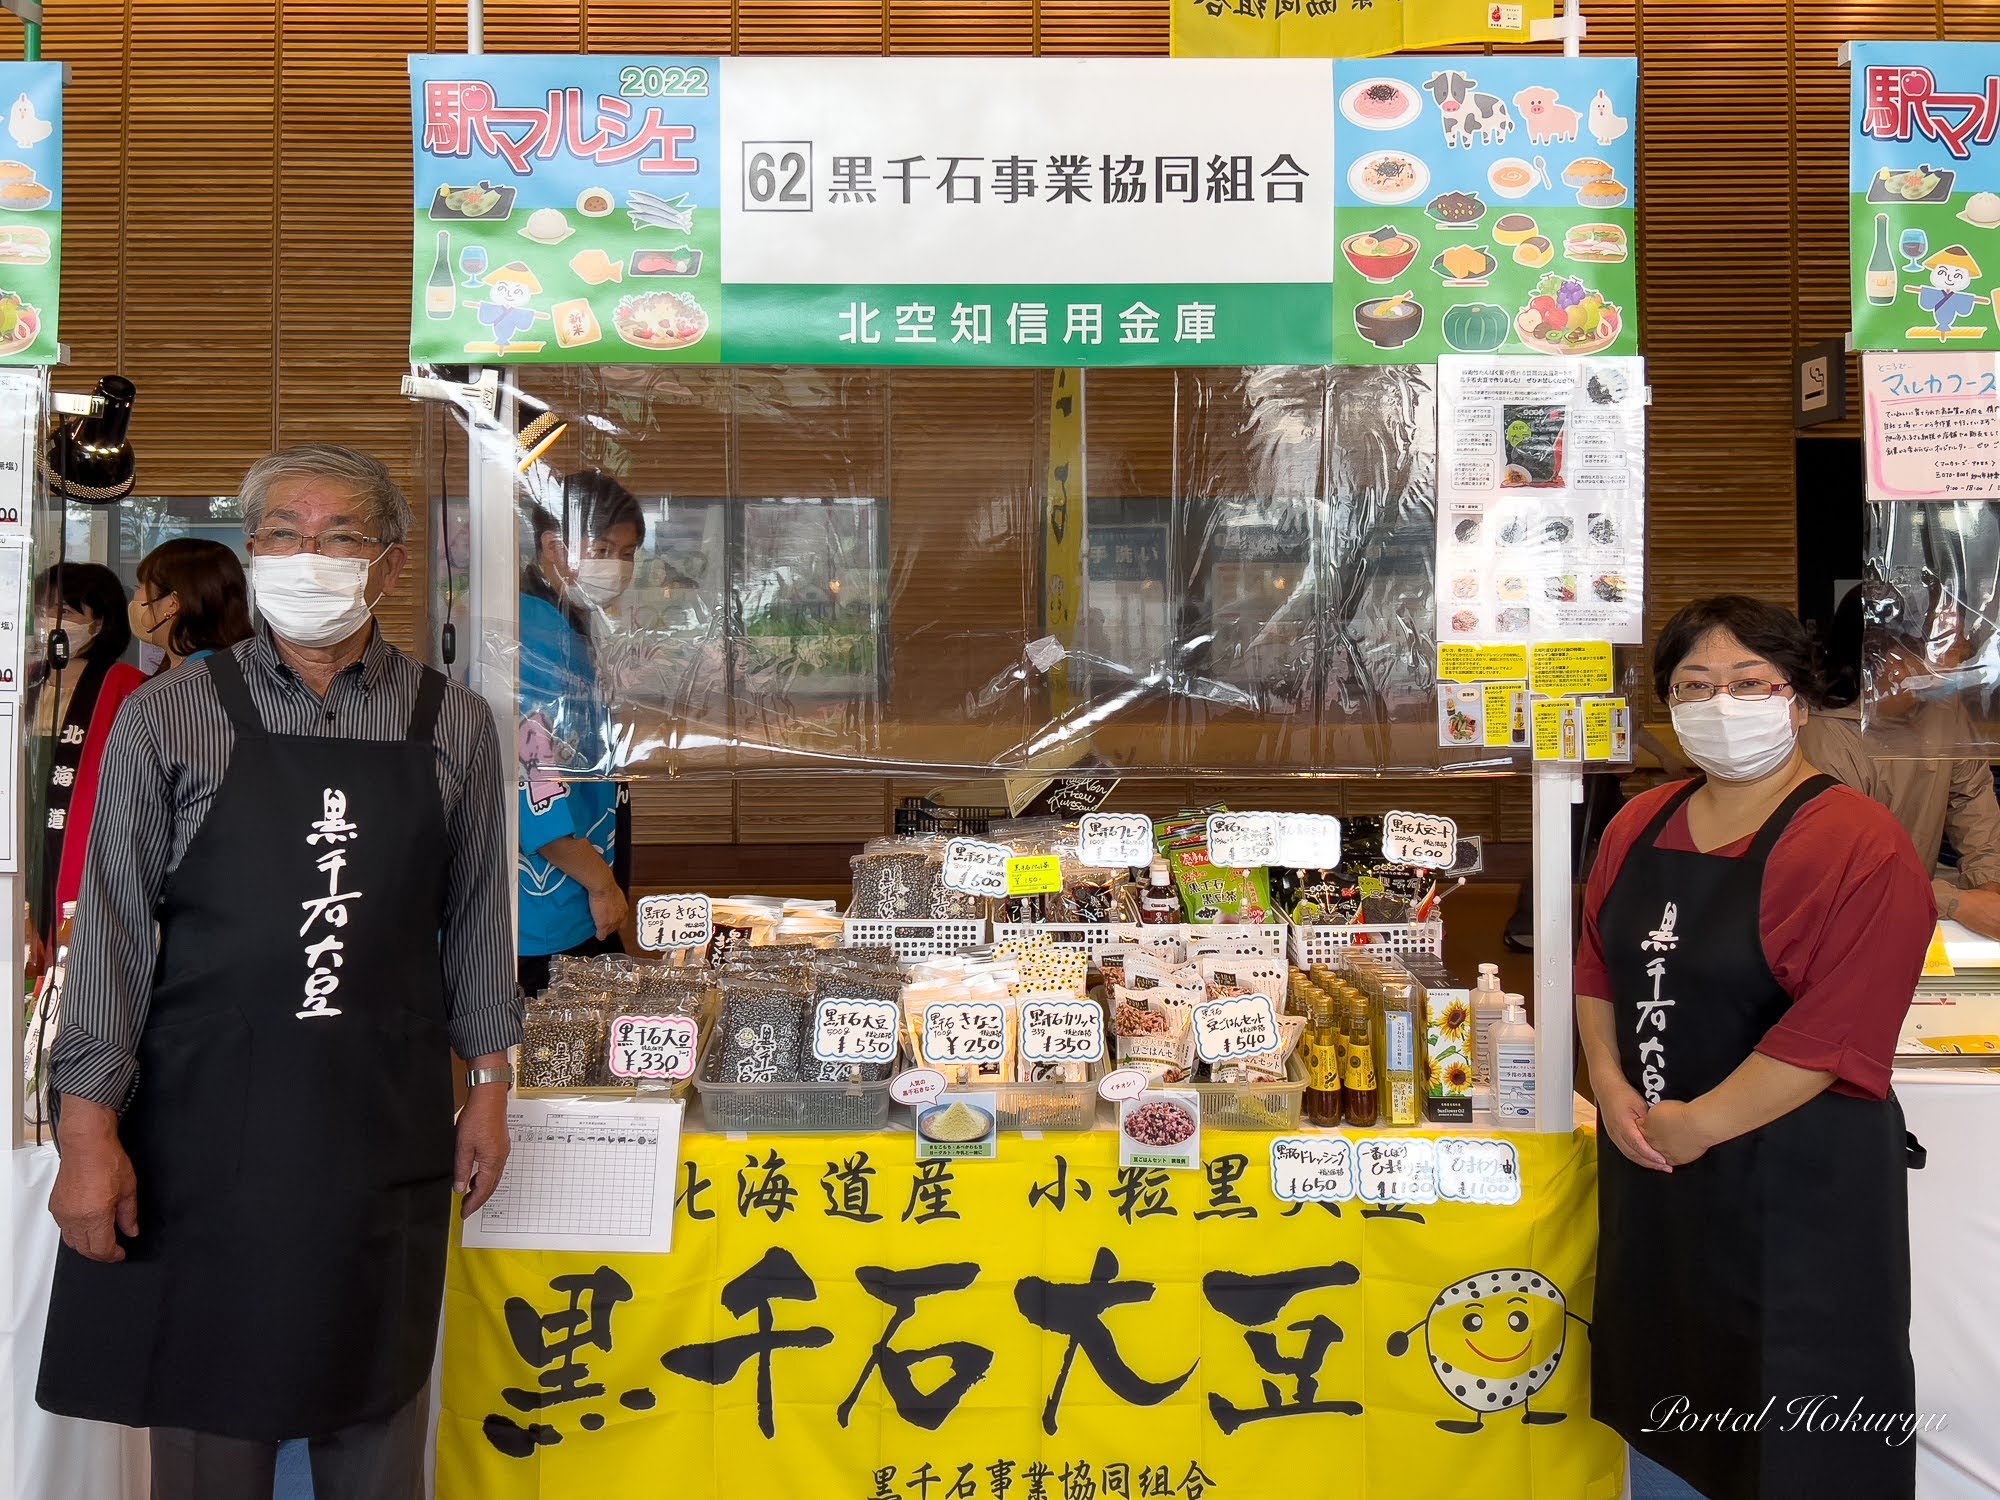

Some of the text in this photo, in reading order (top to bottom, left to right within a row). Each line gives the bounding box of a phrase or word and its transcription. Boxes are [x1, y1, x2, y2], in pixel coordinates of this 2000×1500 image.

[620, 66, 709, 96] 2022
[423, 79, 700, 175] 駅マルシェ
[748, 152, 1310, 205] 62 黒千石事業協同組合
[839, 301, 1218, 346] 北空知信用金庫
[46, 724, 84, 831] 北海道
[295, 787, 363, 1020] 黒千石大豆
[676, 905, 707, 920] きなこ
[1636, 901, 1680, 1107] 黒千石大豆
[823, 1008, 889, 1030] 黒千石大豆
[929, 1012, 999, 1030] 黒千石 きなこ
[1029, 1008, 1098, 1028] 黒千石カリッと
[1206, 1013, 1265, 1033] 豆ごはんセット
[617, 1022, 692, 1049] 黒千石大豆
[838, 1036, 890, 1053] ¥550
[946, 1036, 1000, 1055] ¥250
[1043, 1036, 1091, 1054] ¥350
[1224, 1034, 1265, 1053] ¥540
[624, 1050, 679, 1072] ¥330
[902, 1084, 936, 1096] 黒千石きなこ
[909, 1079, 926, 1087] 人気の
[1290, 1178, 1337, 1194] ¥650
[483, 1246, 1363, 1458] 黒千石大豆
[866, 1458, 1217, 1500] 黒千石事業協同組合
